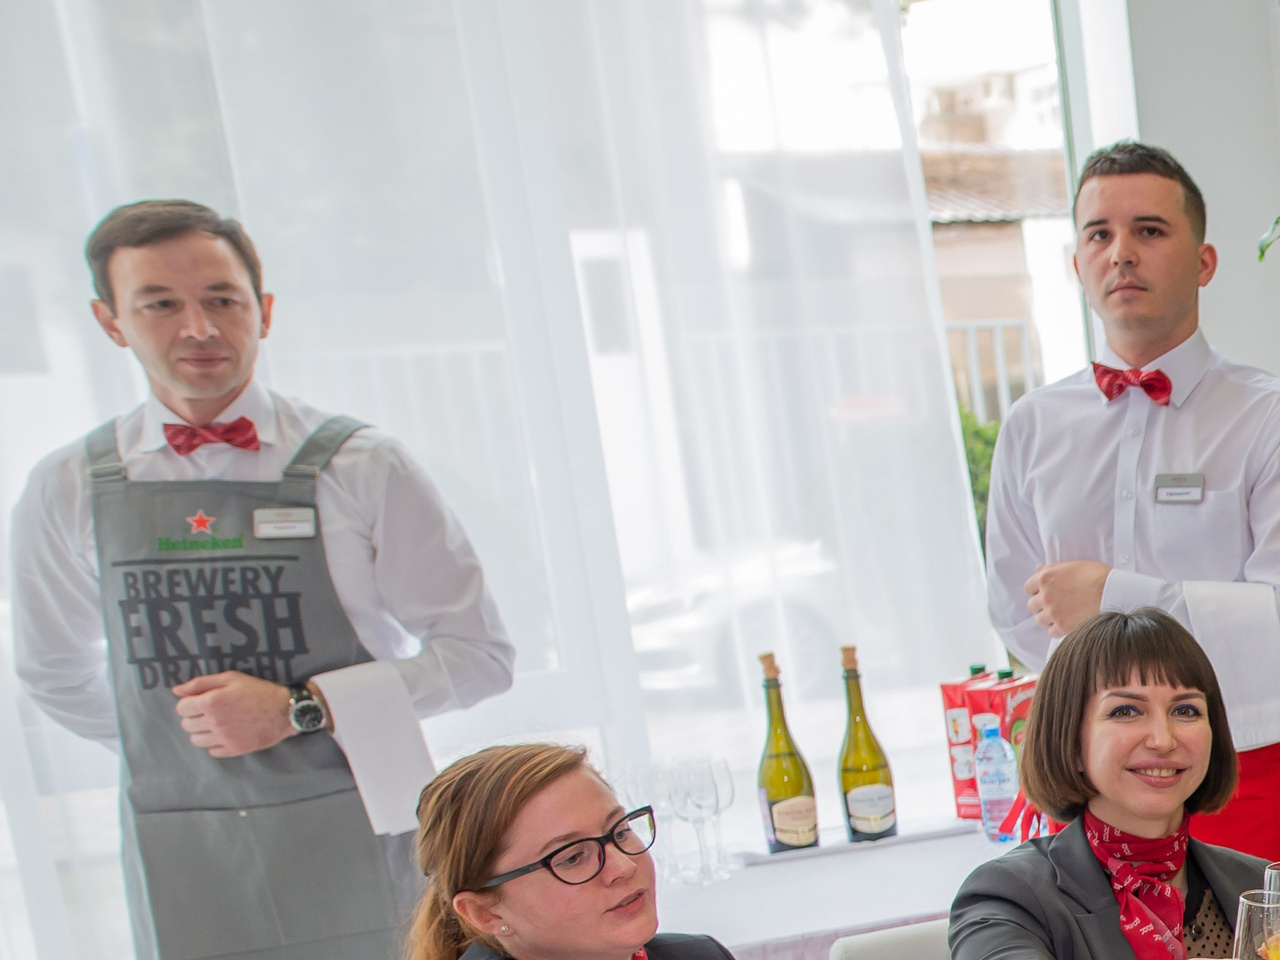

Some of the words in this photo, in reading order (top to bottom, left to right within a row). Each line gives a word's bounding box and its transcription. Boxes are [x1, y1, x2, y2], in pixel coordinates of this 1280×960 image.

[157, 534, 243, 551] Heineken
[122, 565, 285, 601] BREWERY
[118, 592, 310, 664] FRESH
